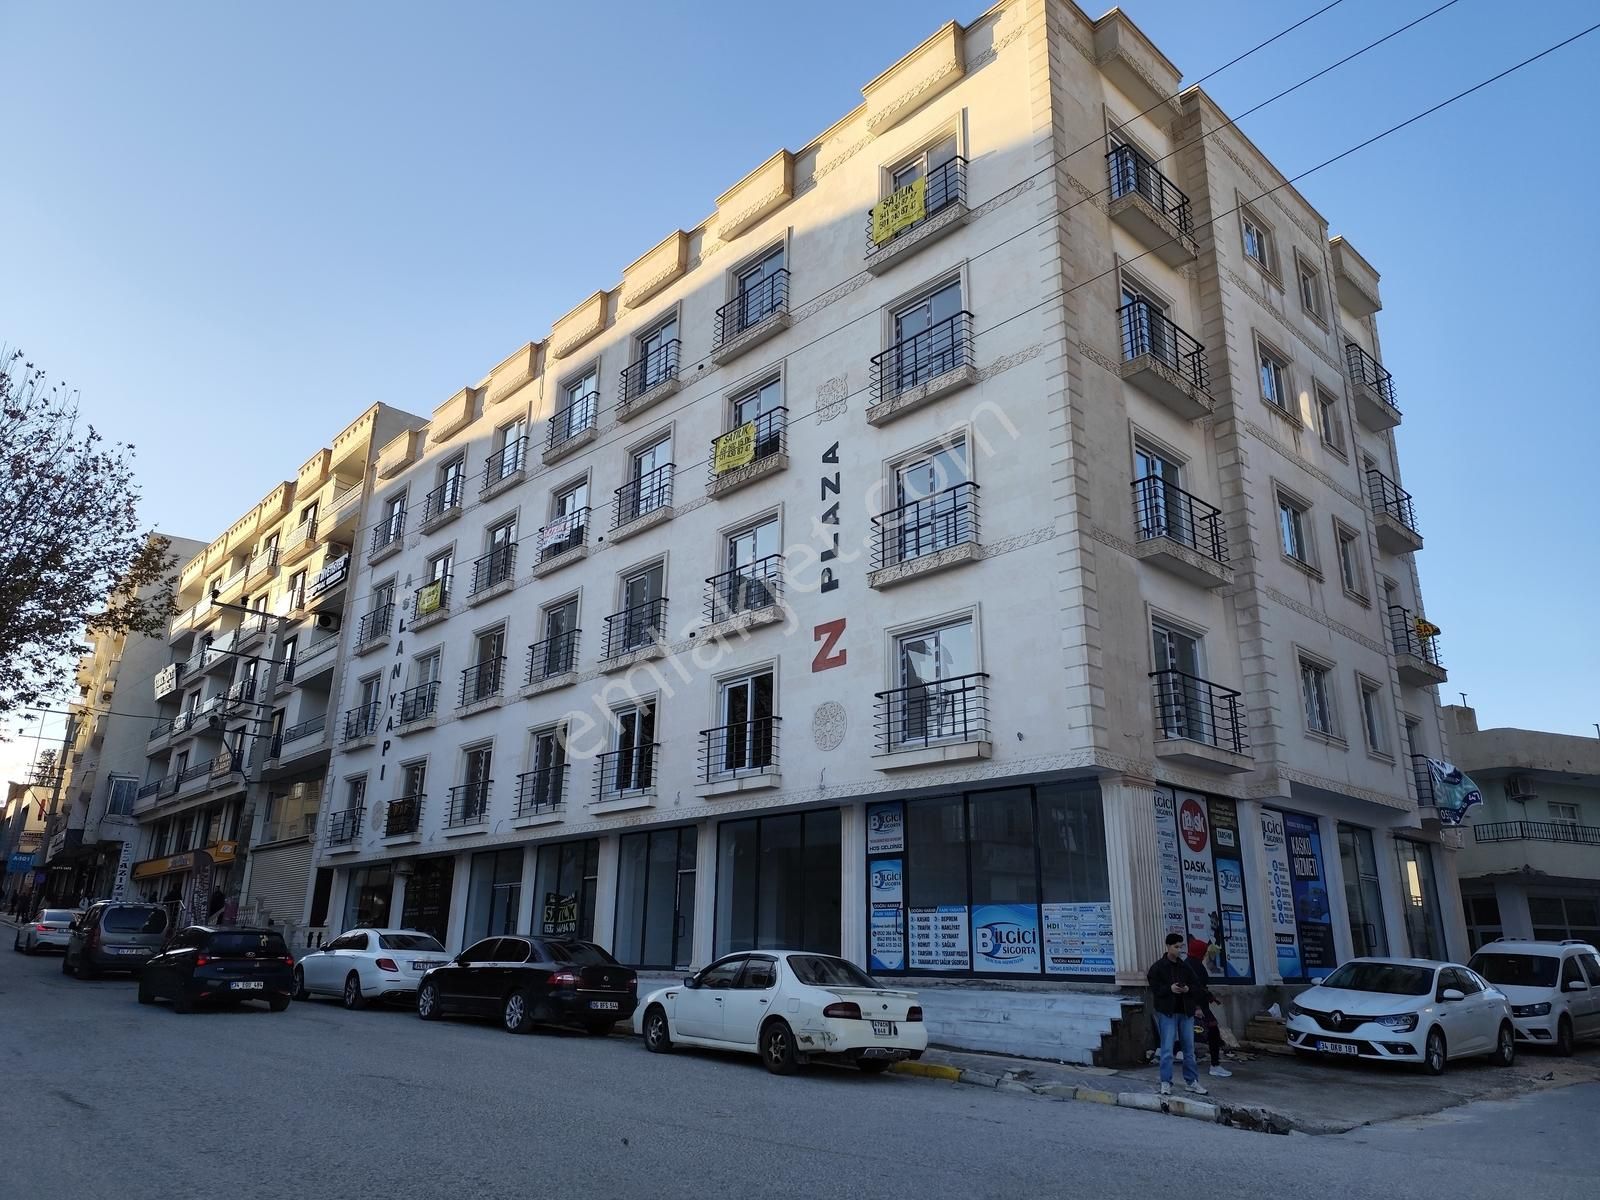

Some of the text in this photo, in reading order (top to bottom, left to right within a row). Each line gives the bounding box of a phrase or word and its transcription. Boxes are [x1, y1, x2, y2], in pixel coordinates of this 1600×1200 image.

[883, 184, 914, 209] SATILIK
[723, 426, 749, 444] SATILIK
[812, 440, 847, 673] Z PLAZA
[380, 693, 397, 781] YAPI
[1290, 835, 1312, 855] KASKO
[1184, 860, 1206, 873] DASK
